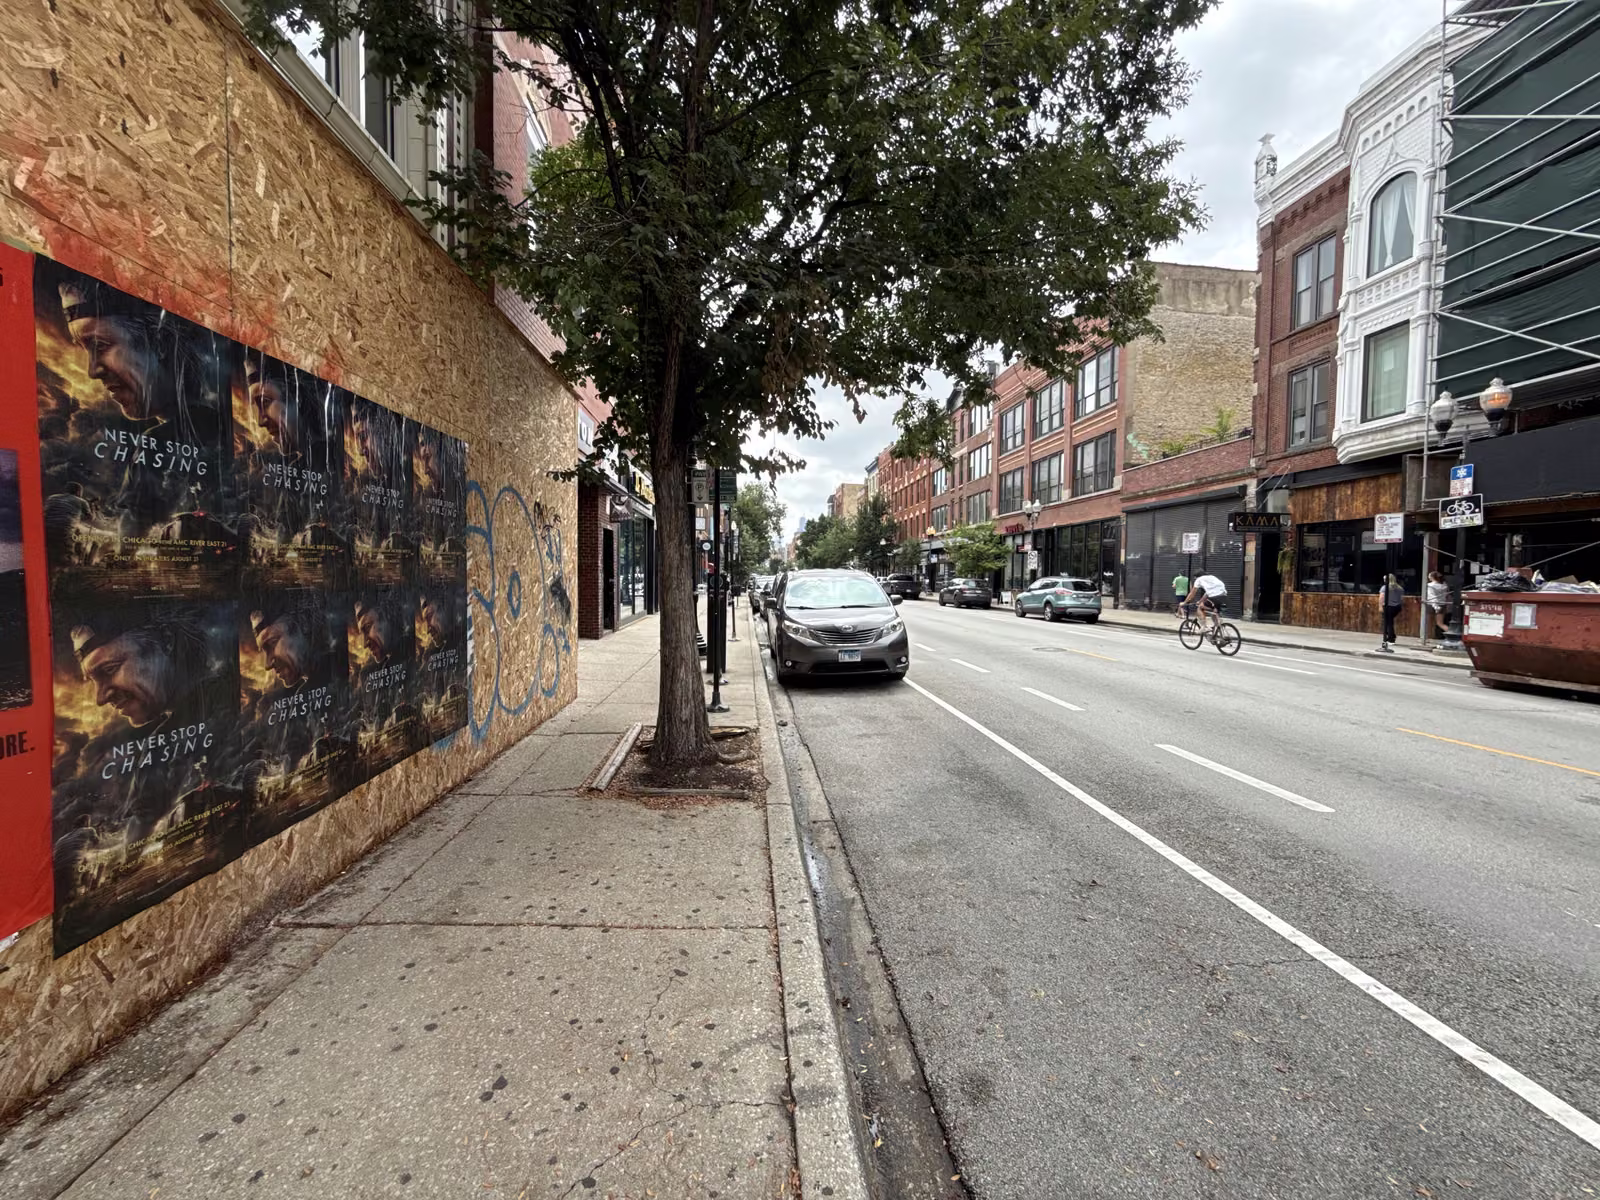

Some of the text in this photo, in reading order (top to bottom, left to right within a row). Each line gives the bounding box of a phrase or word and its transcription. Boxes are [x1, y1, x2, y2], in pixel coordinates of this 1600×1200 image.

[104, 427, 199, 459] NEVER STOP
[94, 442, 208, 476] CHASING
[268, 462, 322, 482] NEVER STOP
[262, 473, 327, 495] CHASING
[366, 484, 400, 498] NEVER STOP
[361, 492, 404, 509] CHASING
[425, 504, 457, 518] CHASING
[122, 535, 158, 545] CHICAGO
[189, 539, 206, 547] RIVER
[113, 554, 131, 562] ONLY
[368, 663, 403, 681] NEVER STOP
[427, 655, 459, 672] CHASING
[365, 670, 407, 693] CHASING
[273, 686, 327, 710] NEVER STOP
[268, 694, 331, 726] CHASING
[113, 722, 205, 759] NEVER STOP
[102, 732, 213, 780] CHASING
[193, 809, 211, 821] RIVER
